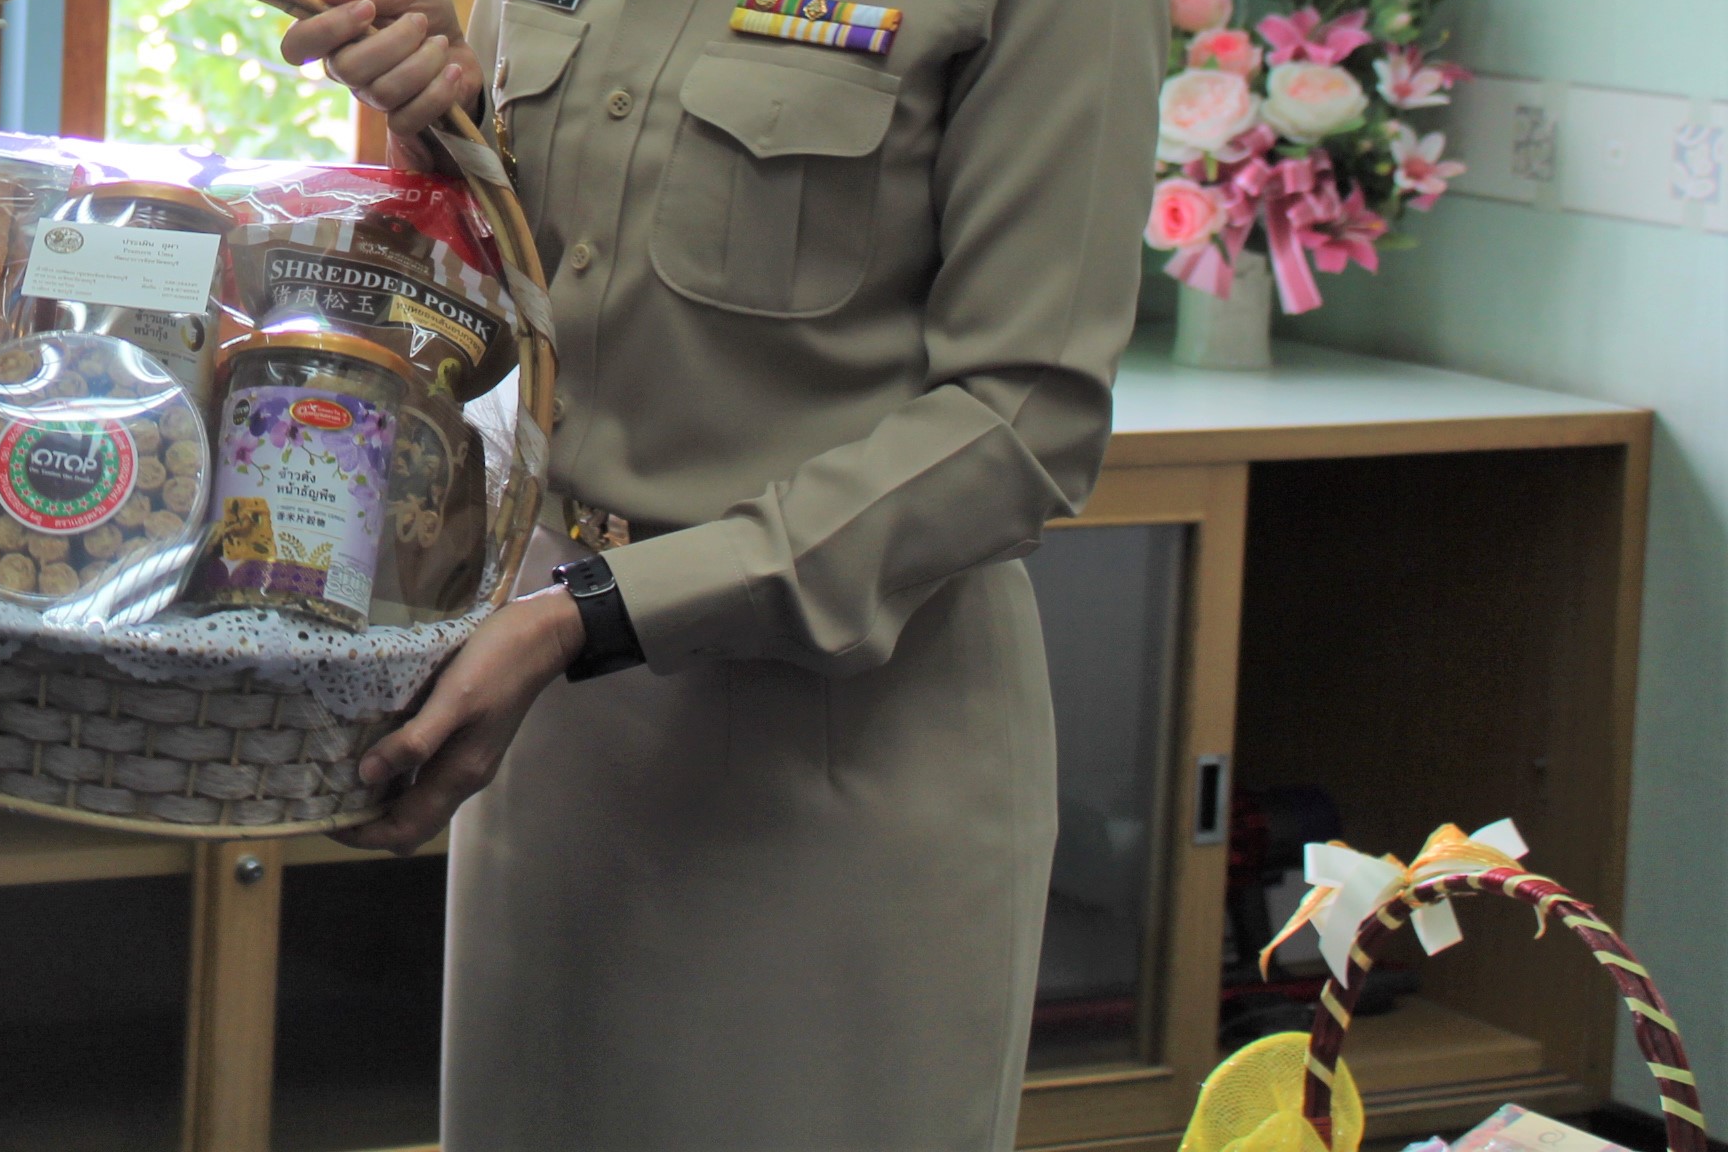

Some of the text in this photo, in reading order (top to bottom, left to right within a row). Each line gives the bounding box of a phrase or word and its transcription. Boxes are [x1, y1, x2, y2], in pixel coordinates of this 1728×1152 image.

[270, 258, 418, 299] SHREDDED
[423, 287, 492, 343] PORK
[31, 447, 98, 475] OTOP
[278, 466, 317, 484] ข้าวตัง
[276, 481, 336, 503] หน้าธัญพืช
